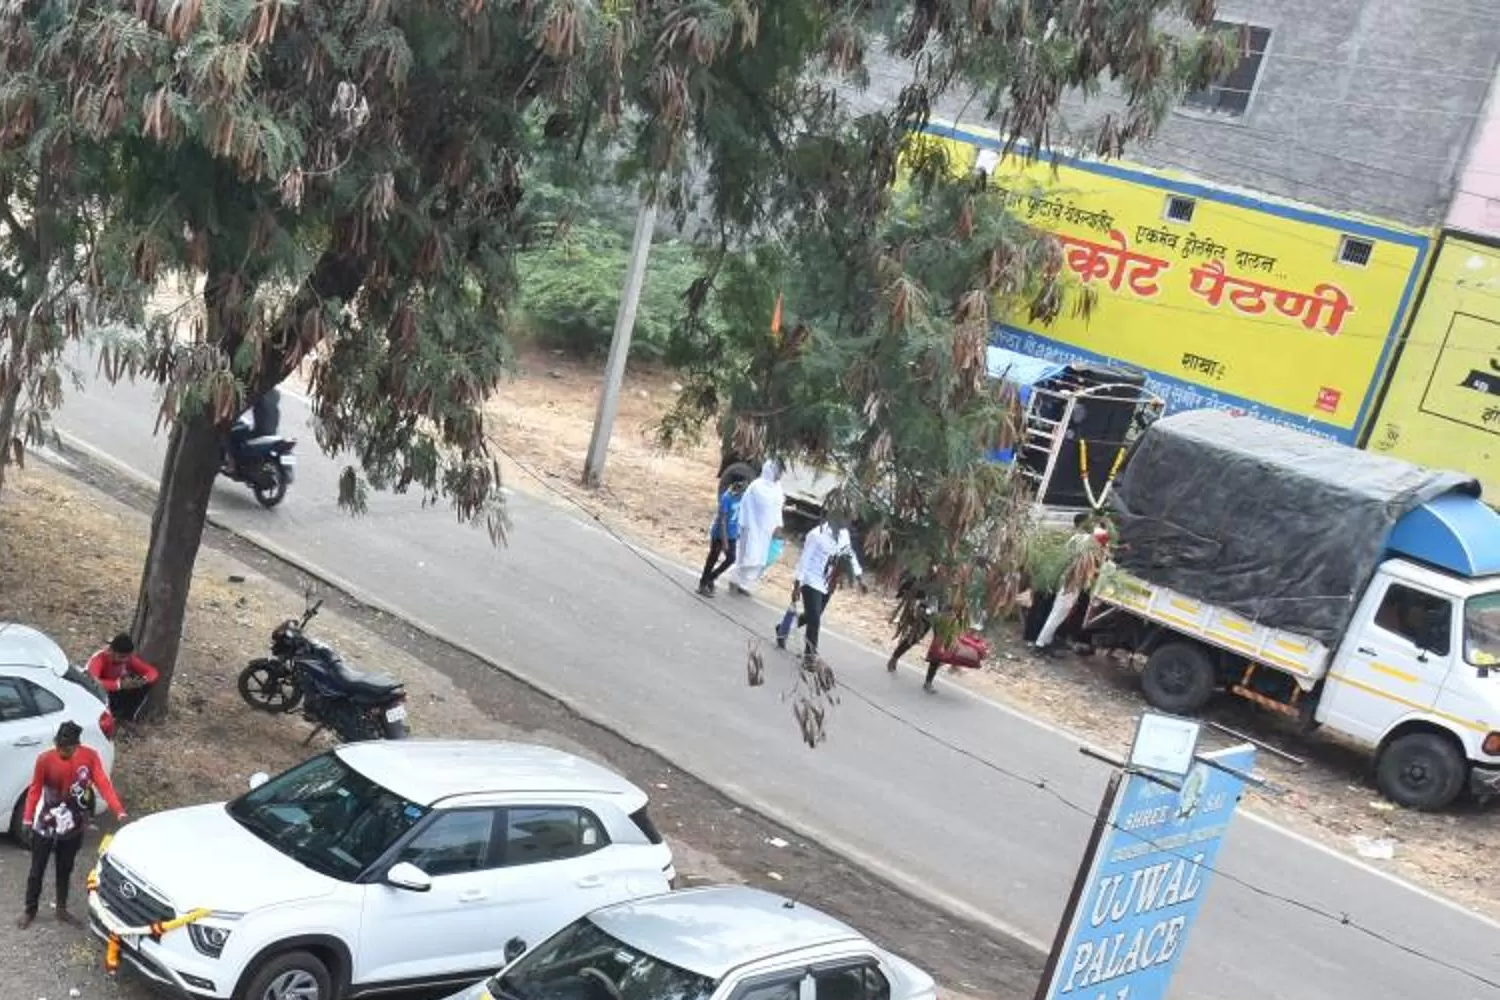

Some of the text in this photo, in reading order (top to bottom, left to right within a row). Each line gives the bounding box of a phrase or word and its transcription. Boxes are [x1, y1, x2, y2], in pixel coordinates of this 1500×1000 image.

[1062, 229, 1356, 337] कोट पैठणी
[1090, 853, 1205, 928] UJWAL
[1060, 915, 1186, 994] PALACE
